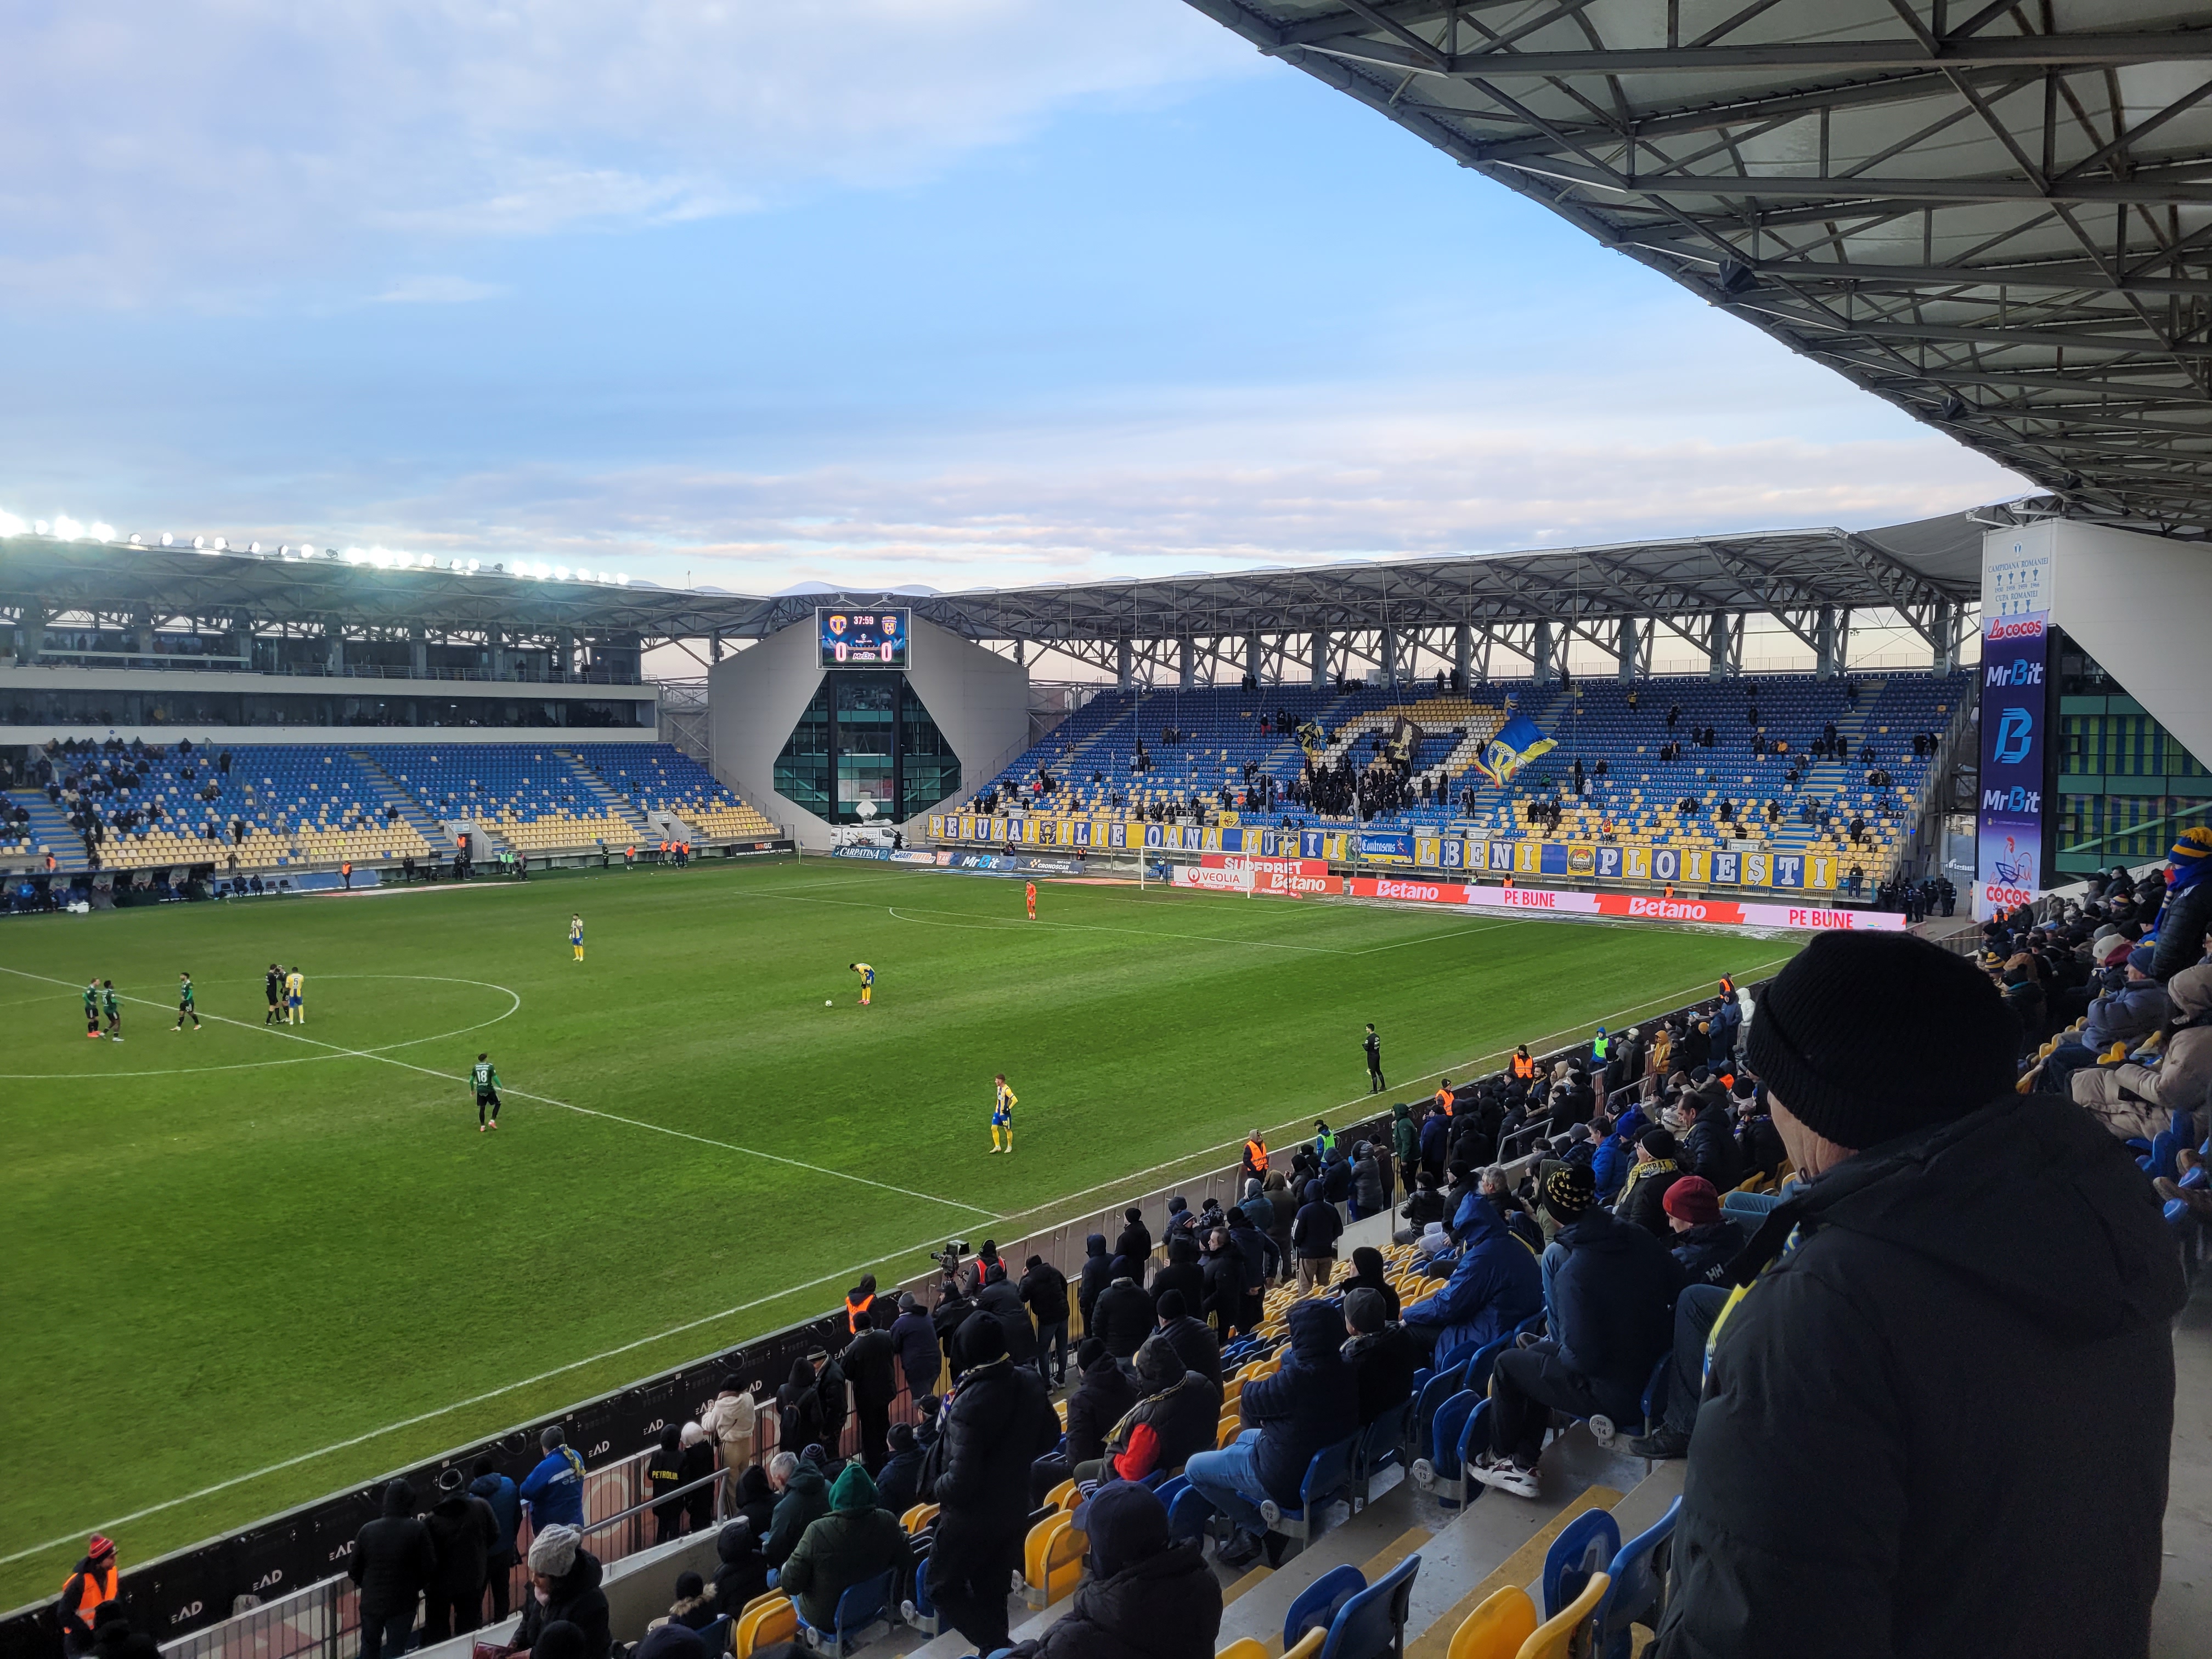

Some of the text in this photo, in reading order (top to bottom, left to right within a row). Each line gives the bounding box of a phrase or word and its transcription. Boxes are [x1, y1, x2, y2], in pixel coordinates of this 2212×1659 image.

[1988, 557, 2049, 573] CAMPIOANA ROMANIEI
[2011, 590, 2038, 600] ROMANIEI
[854, 616, 874, 625] 37:59
[836, 642, 847, 662] 0
[853, 652, 876, 660] MrBit
[881, 642, 892, 662] 0
[1985, 659, 2044, 687] MrBit
[1982, 786, 2040, 813] MrBit
[932, 816, 1022, 841] PELUZA
[1061, 822, 1123, 847] ILIE
[1148, 826, 1220, 851] OANĂ
[1374, 839, 1533, 871] LBENI
[1362, 839, 1396, 853] Contrasens
[840, 847, 879, 859] CARPATINA
[962, 855, 1000, 868] MrBit
[1224, 857, 1303, 874] SUPERBET
[1202, 872, 1240, 883] VEOLIA
[1271, 874, 1326, 891] Betano
[1376, 880, 1438, 900] Betano
[1504, 890, 1555, 907] PE BUNE
[1629, 898, 1707, 919] Betano
[1790, 910, 1854, 929] PE BUNE
[477, 1070, 487, 1083] 18
[1706, 1263, 1724, 1282] HH
[744, 1380, 763, 1393] AD
